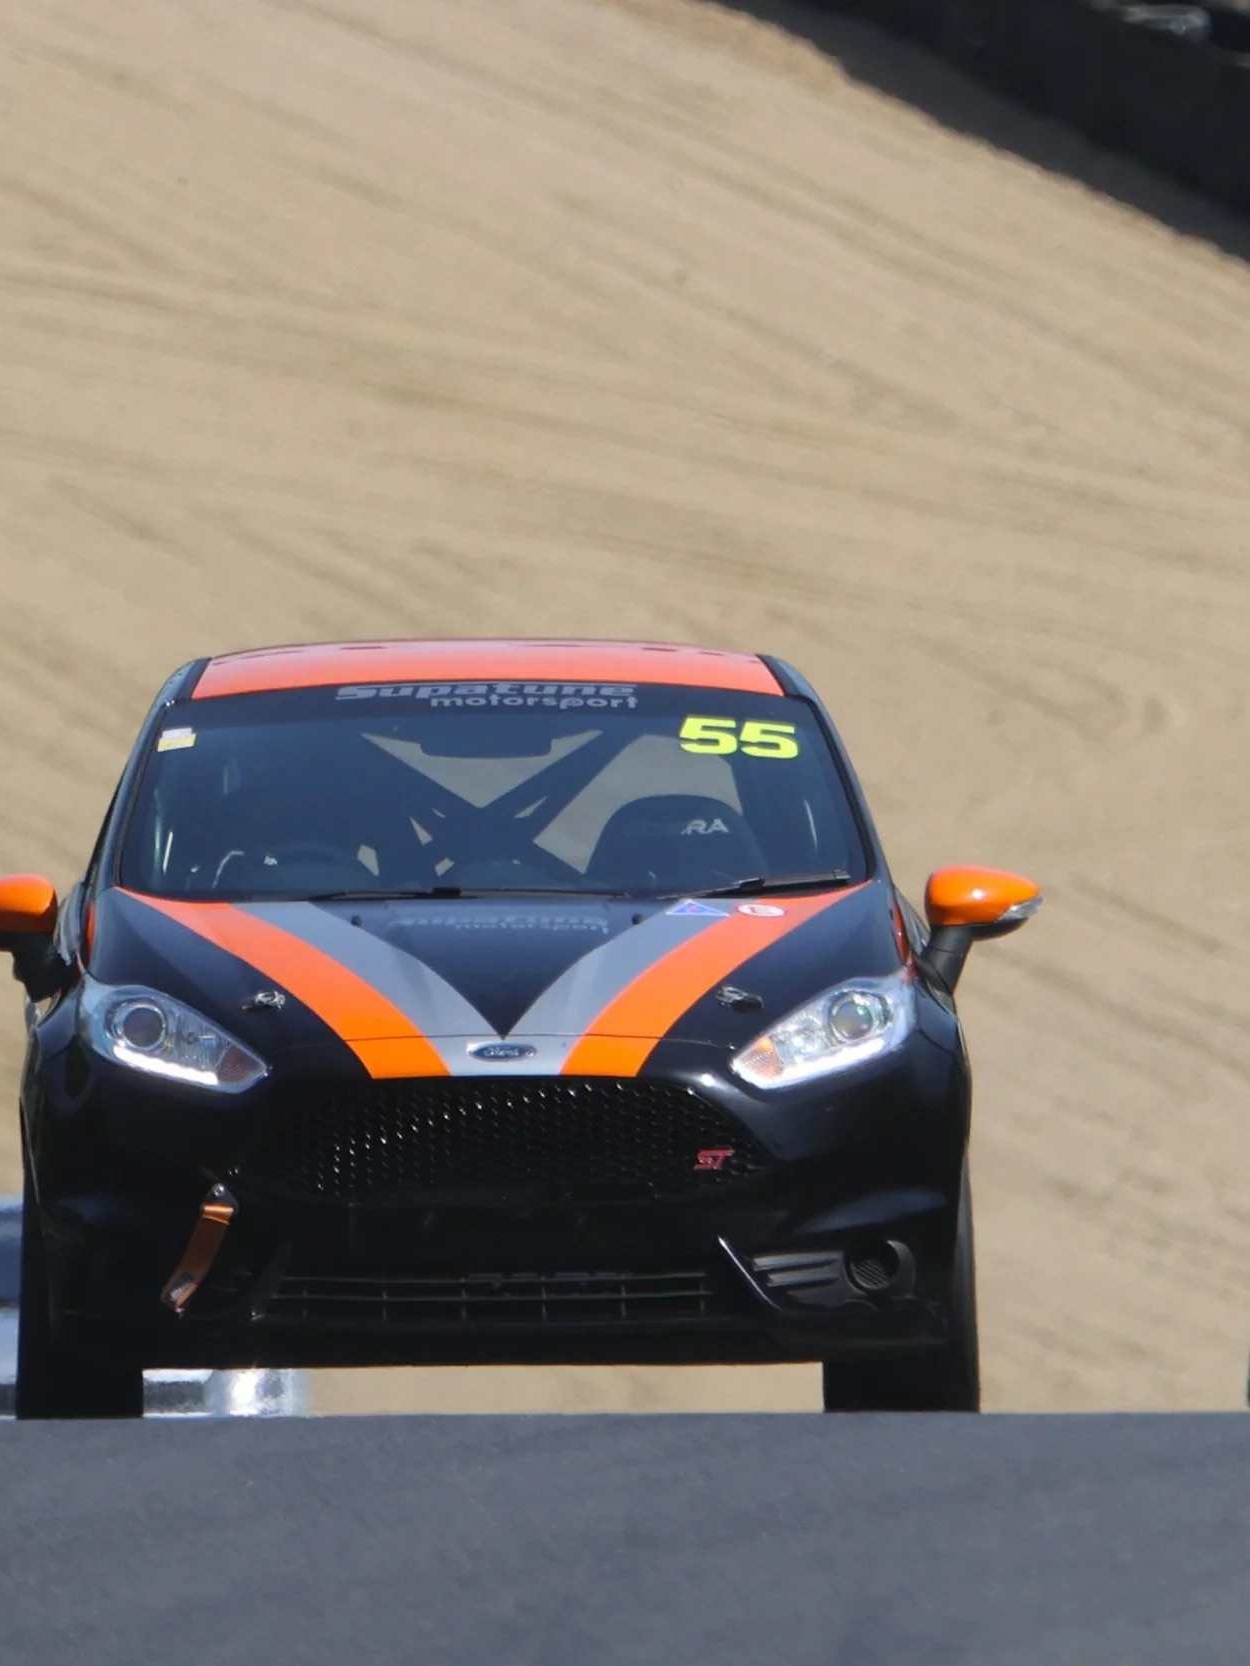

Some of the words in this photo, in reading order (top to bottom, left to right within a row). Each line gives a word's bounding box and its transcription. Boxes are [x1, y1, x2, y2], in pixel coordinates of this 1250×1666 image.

[335, 682, 637, 700] Supatune
[430, 694, 638, 709] motorsport
[678, 716, 799, 760] 55
[695, 1149, 735, 1170] ST
